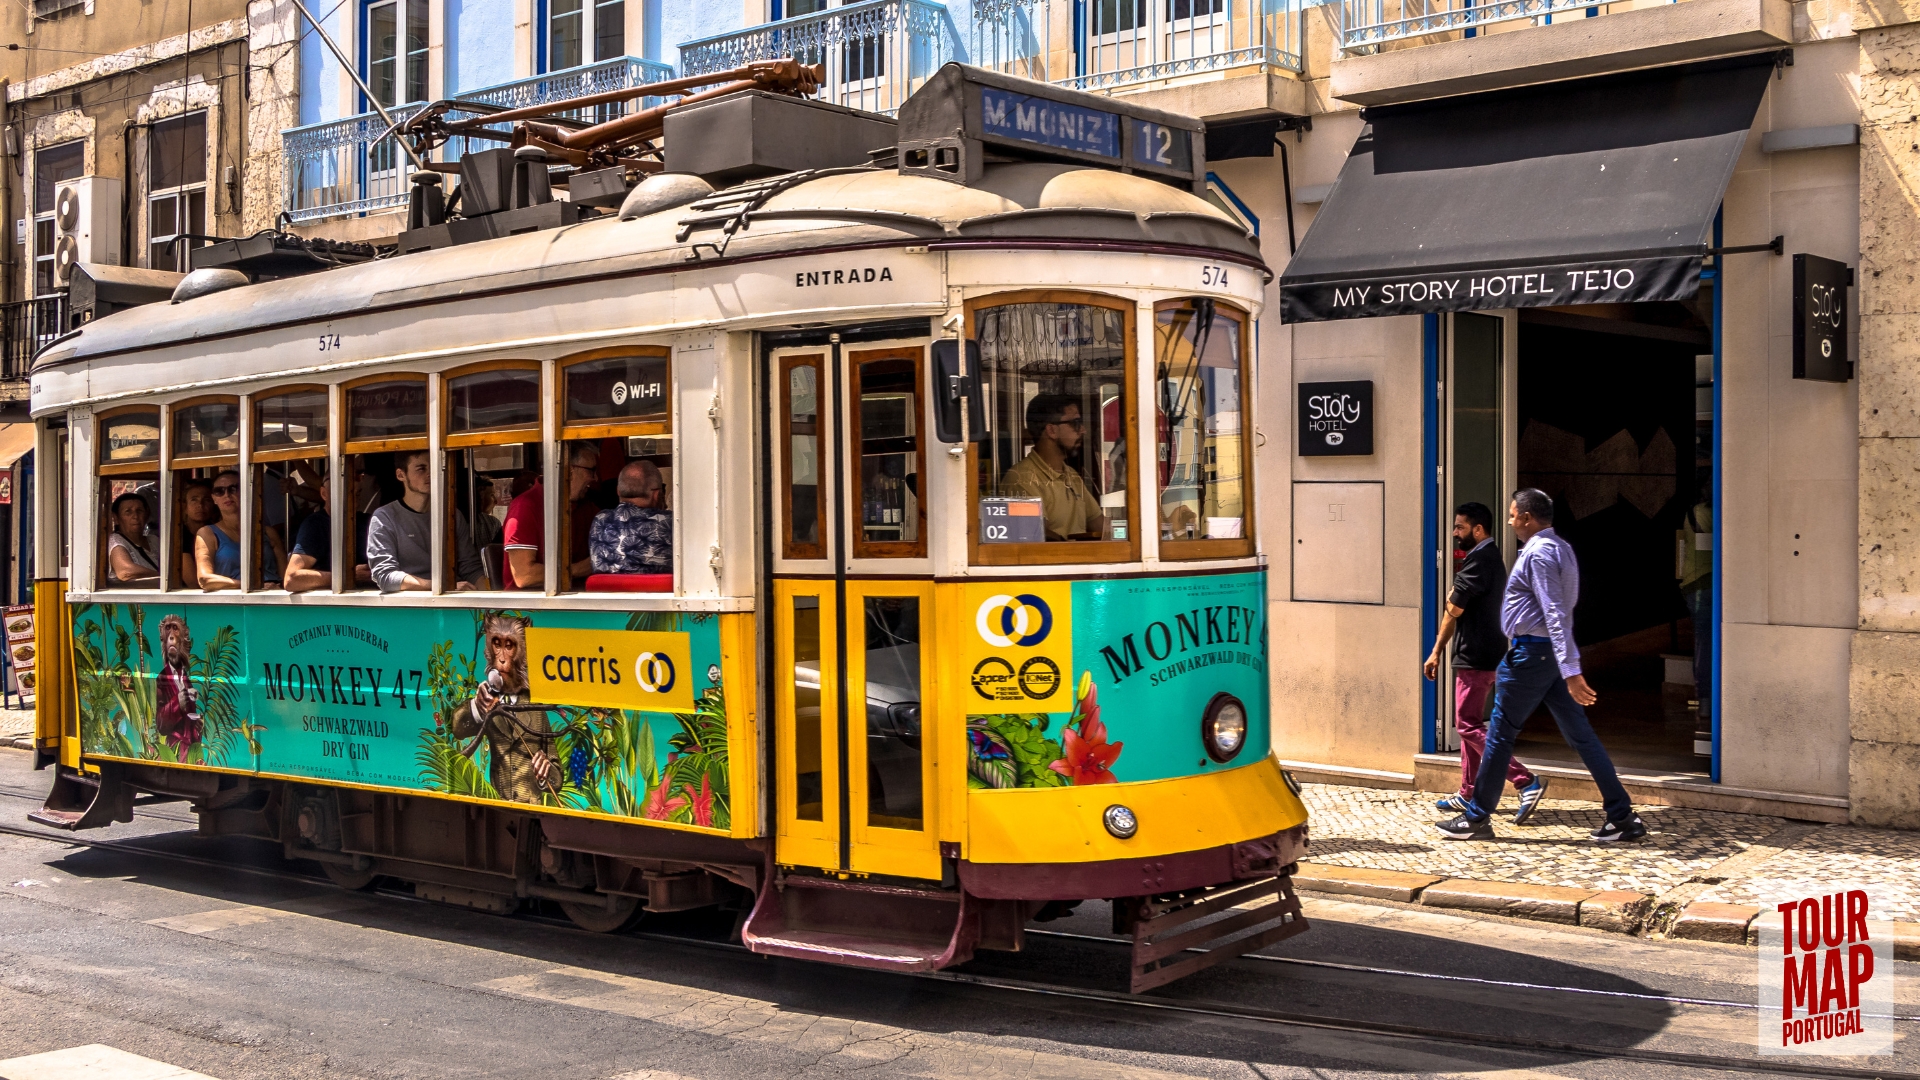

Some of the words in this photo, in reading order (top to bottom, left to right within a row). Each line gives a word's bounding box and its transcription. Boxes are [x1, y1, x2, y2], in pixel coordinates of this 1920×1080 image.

[1142, 124, 1172, 165] 12
[796, 267, 893, 288] ENTRADA
[1202, 265, 1228, 288] 574
[1333, 286, 1371, 307] MY
[1381, 279, 1460, 305] STORY
[1470, 273, 1554, 298] HOTEL
[1567, 268, 1635, 291] TEJO
[319, 333, 341, 352] 574
[630, 382, 661, 399] WI-FI
[1309, 420, 1347, 432] HOTEL
[986, 506, 1007, 517] 12E
[987, 525, 1008, 540] 02
[288, 624, 332, 650] CERTAINLY
[334, 624, 389, 654] WUNDERBAR
[1099, 605, 1256, 685] MONKEY
[542, 645, 621, 685] carris
[1150, 650, 1234, 687] SCHWARZWALD
[1236, 651, 1252, 667] DRY
[263, 662, 383, 708] MONKEY
[392, 668, 423, 711] 47
[302, 715, 389, 738] SCHWARZWALD
[322, 740, 345, 759] DRY
[350, 742, 370, 760] GIN
[346, 769, 365, 777] BEBA
